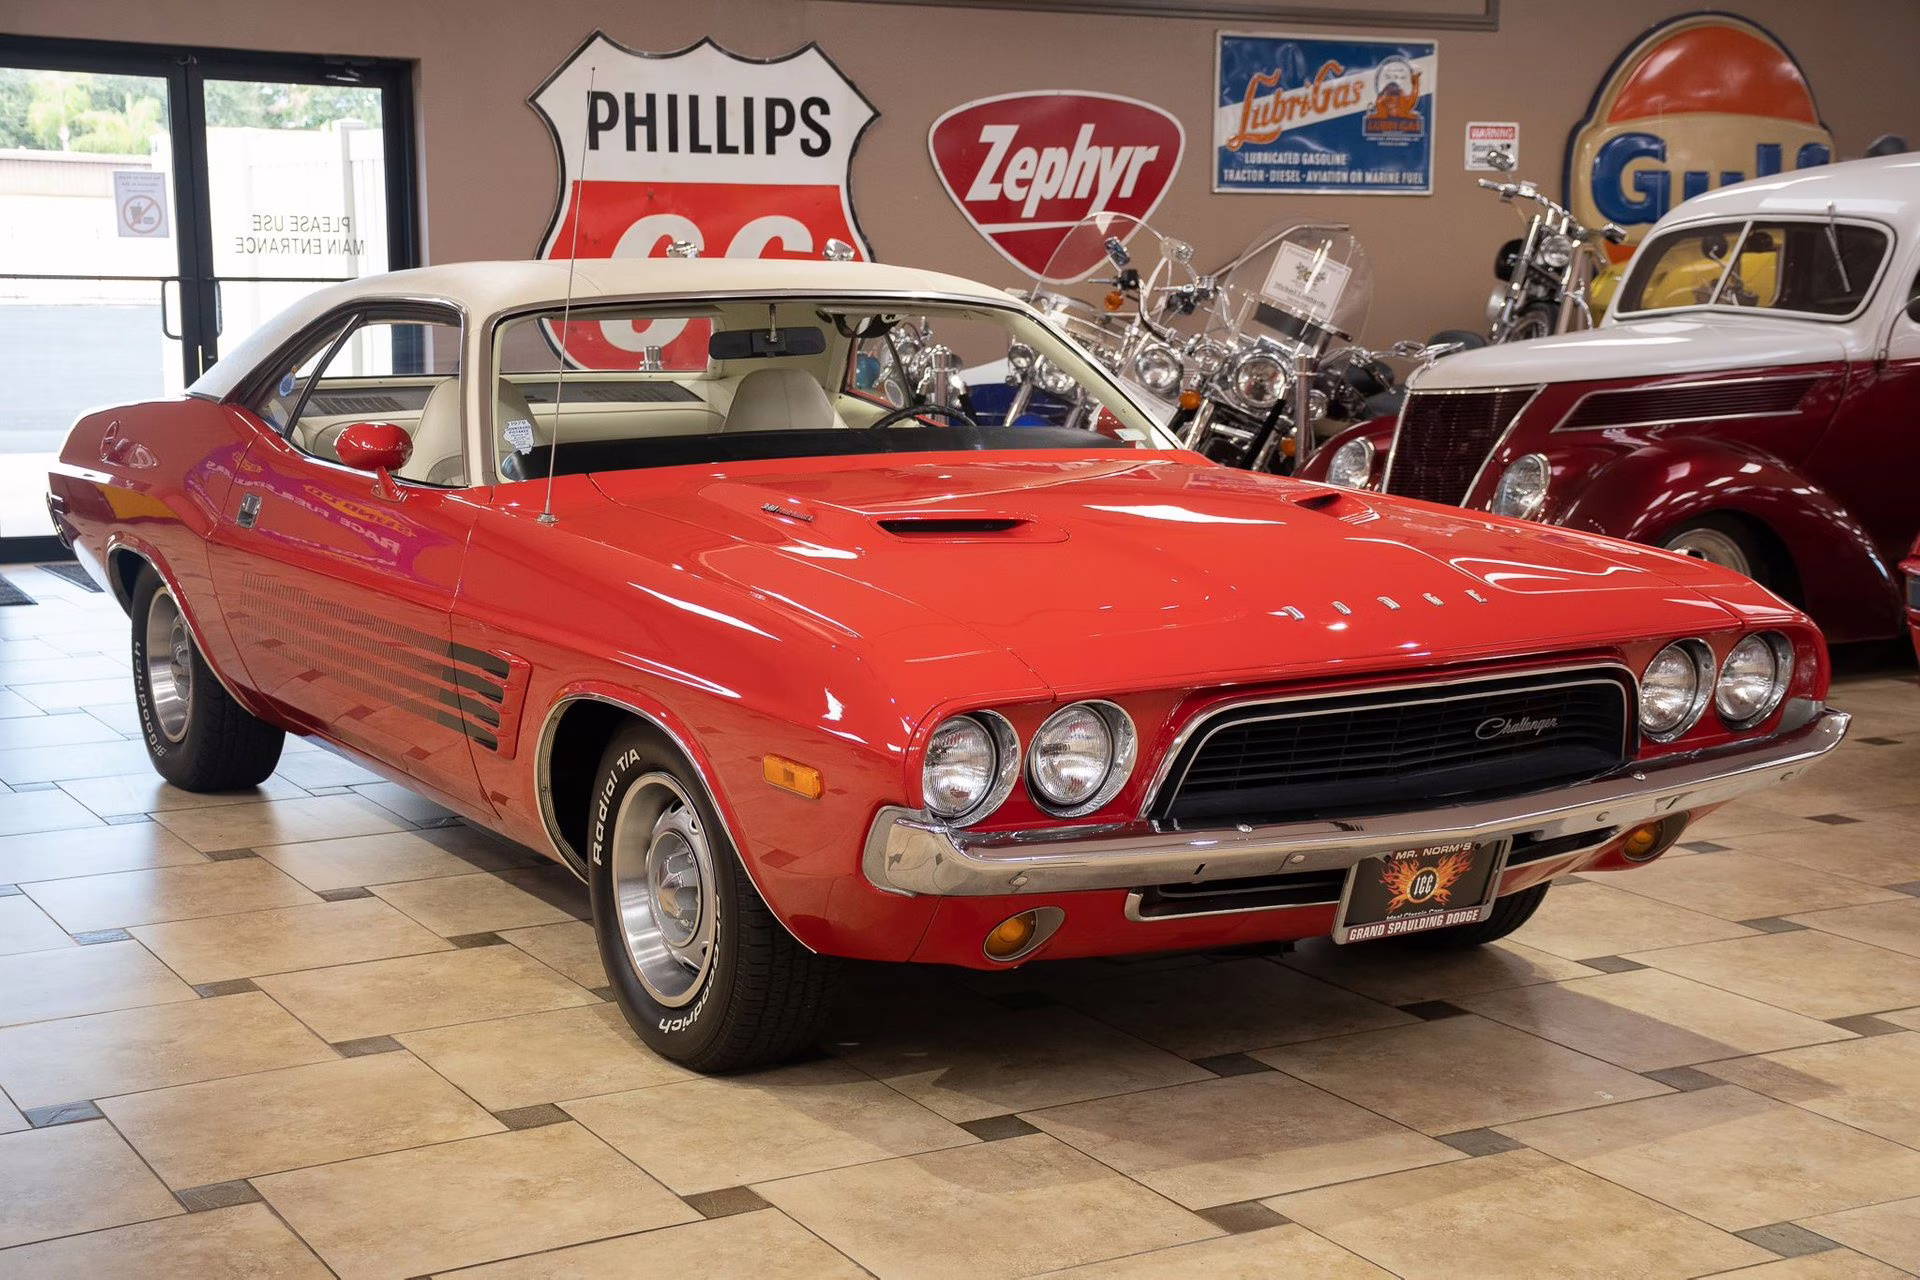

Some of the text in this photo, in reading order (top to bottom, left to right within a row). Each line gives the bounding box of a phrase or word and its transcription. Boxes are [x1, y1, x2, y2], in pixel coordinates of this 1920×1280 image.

[587, 90, 832, 157] PHILLIPS
[1245, 151, 1347, 166] LUBRICATED GASOLINE
[964, 123, 1160, 235] Zephyr
[1223, 168, 1424, 184] TRACTOR DIESEL AVIATION OR MARINE FUEL
[1475, 716, 1558, 740] Challenger
[592, 747, 641, 867] Radial T/A
[1395, 842, 1473, 861] MR. NORM'S
[1349, 909, 1481, 941] GRAND SPAULDING DODGE
